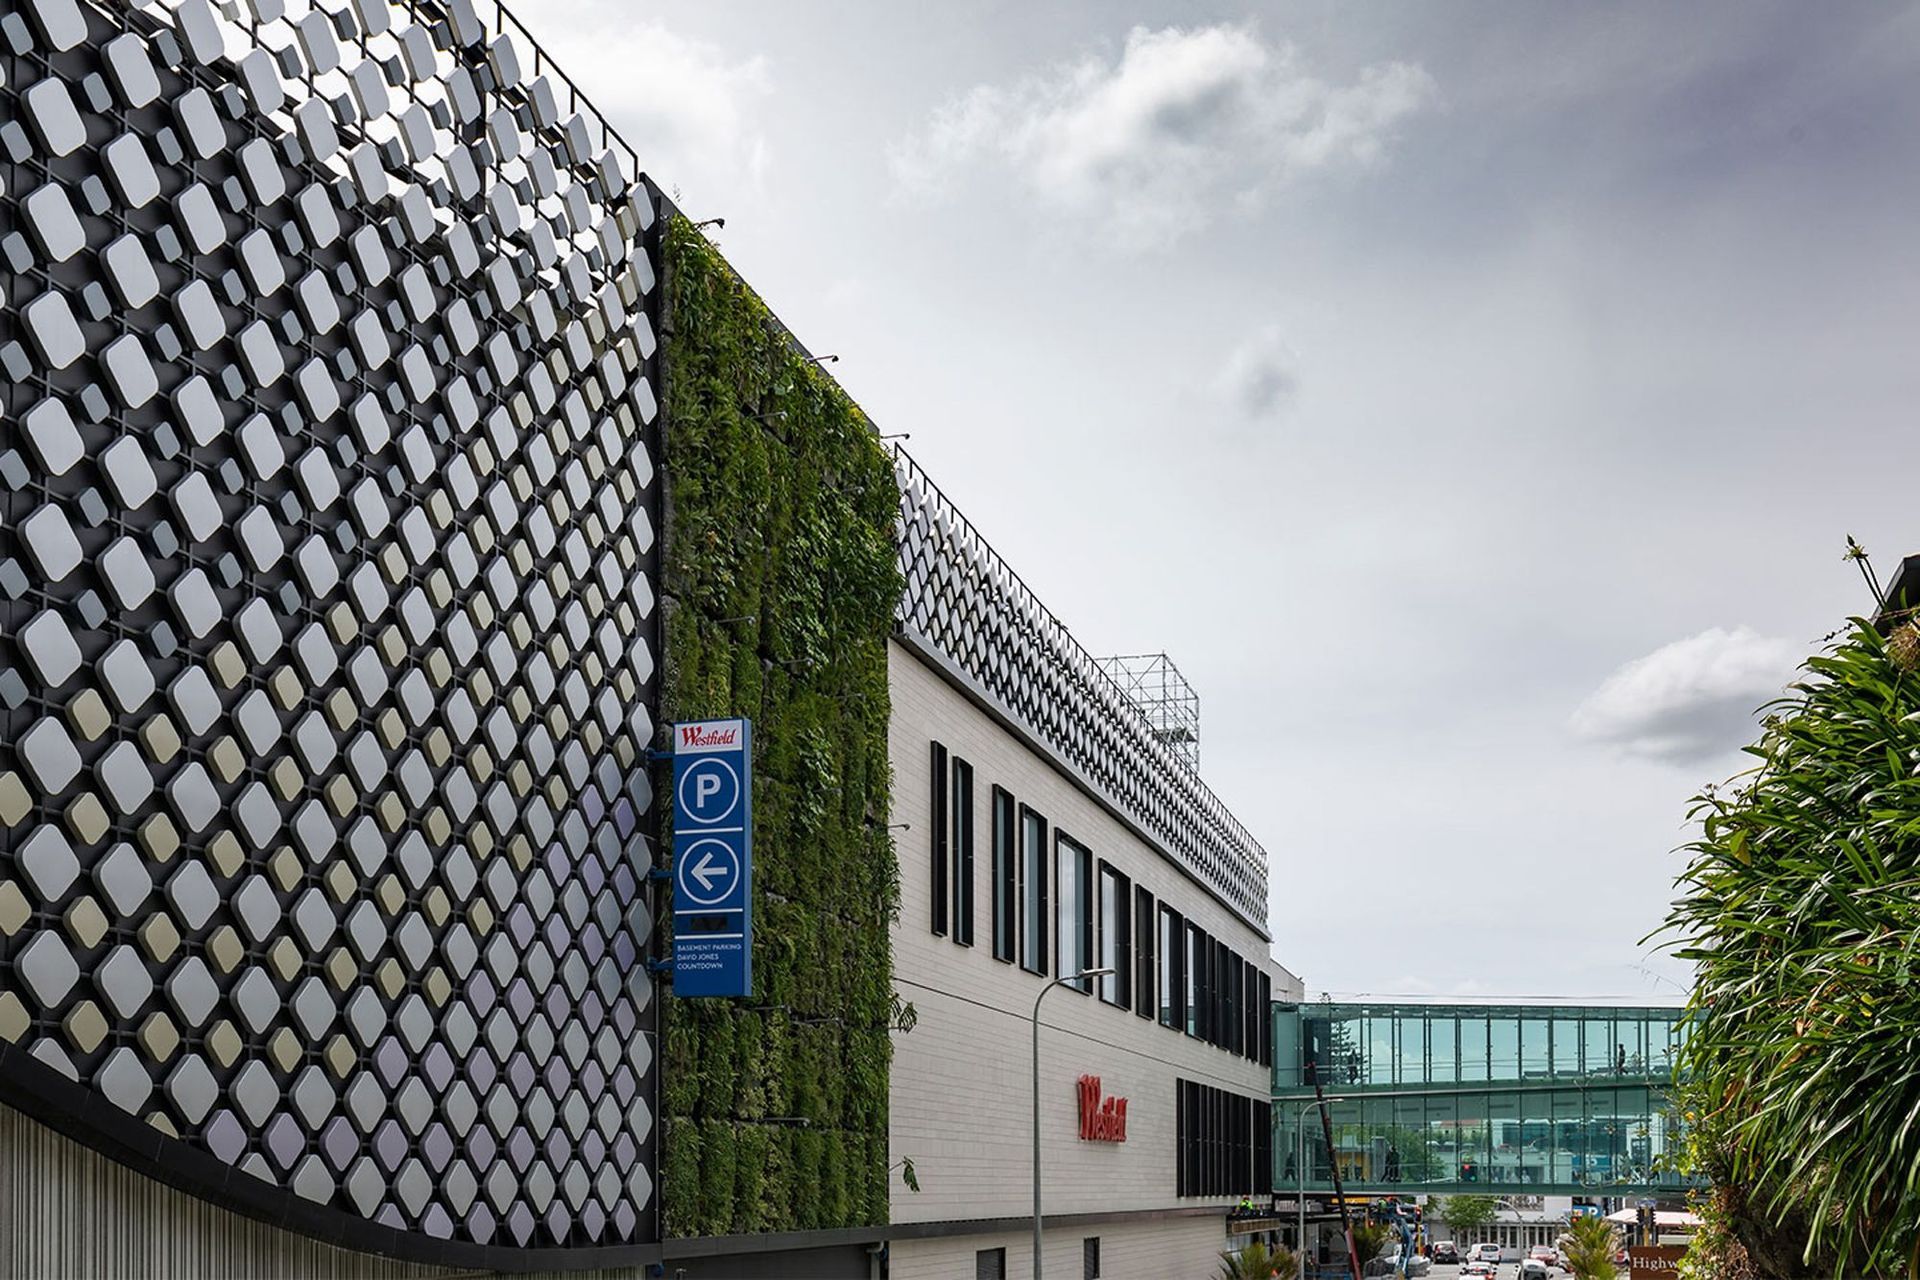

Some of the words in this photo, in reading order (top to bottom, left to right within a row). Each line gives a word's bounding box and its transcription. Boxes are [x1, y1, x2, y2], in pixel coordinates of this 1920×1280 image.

[681, 725, 737, 747] Westfield
[697, 773, 721, 809] P
[677, 944, 711, 952] BASEMENT
[712, 943, 742, 951] PARKING
[677, 953, 698, 961] DAVID
[698, 953, 720, 961] JONES
[677, 962, 724, 970] COUNTDOWN
[1632, 1256, 1678, 1272] Highw
